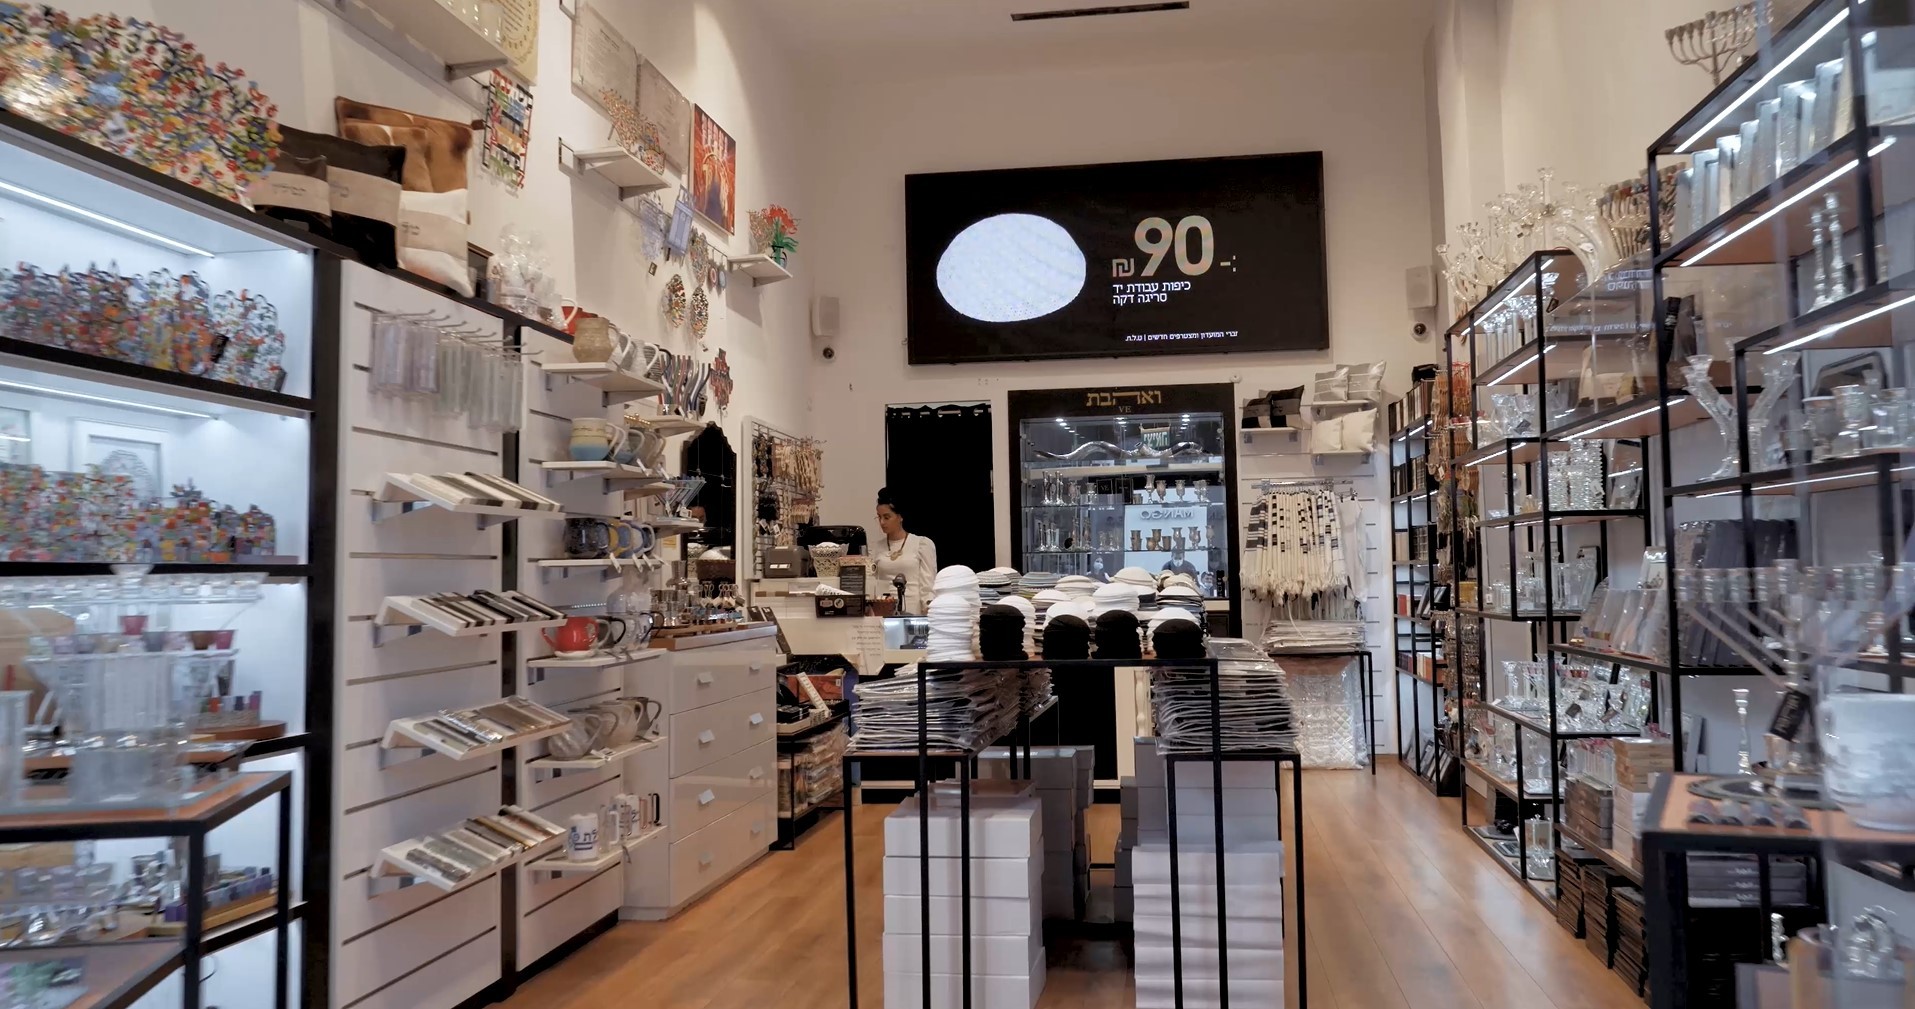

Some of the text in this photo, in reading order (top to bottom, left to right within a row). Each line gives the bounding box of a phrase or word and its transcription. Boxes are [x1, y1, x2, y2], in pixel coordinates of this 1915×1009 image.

[1112, 281, 1191, 294] כיפות עבודת יד
[1112, 293, 1168, 306] סריגה דקה
